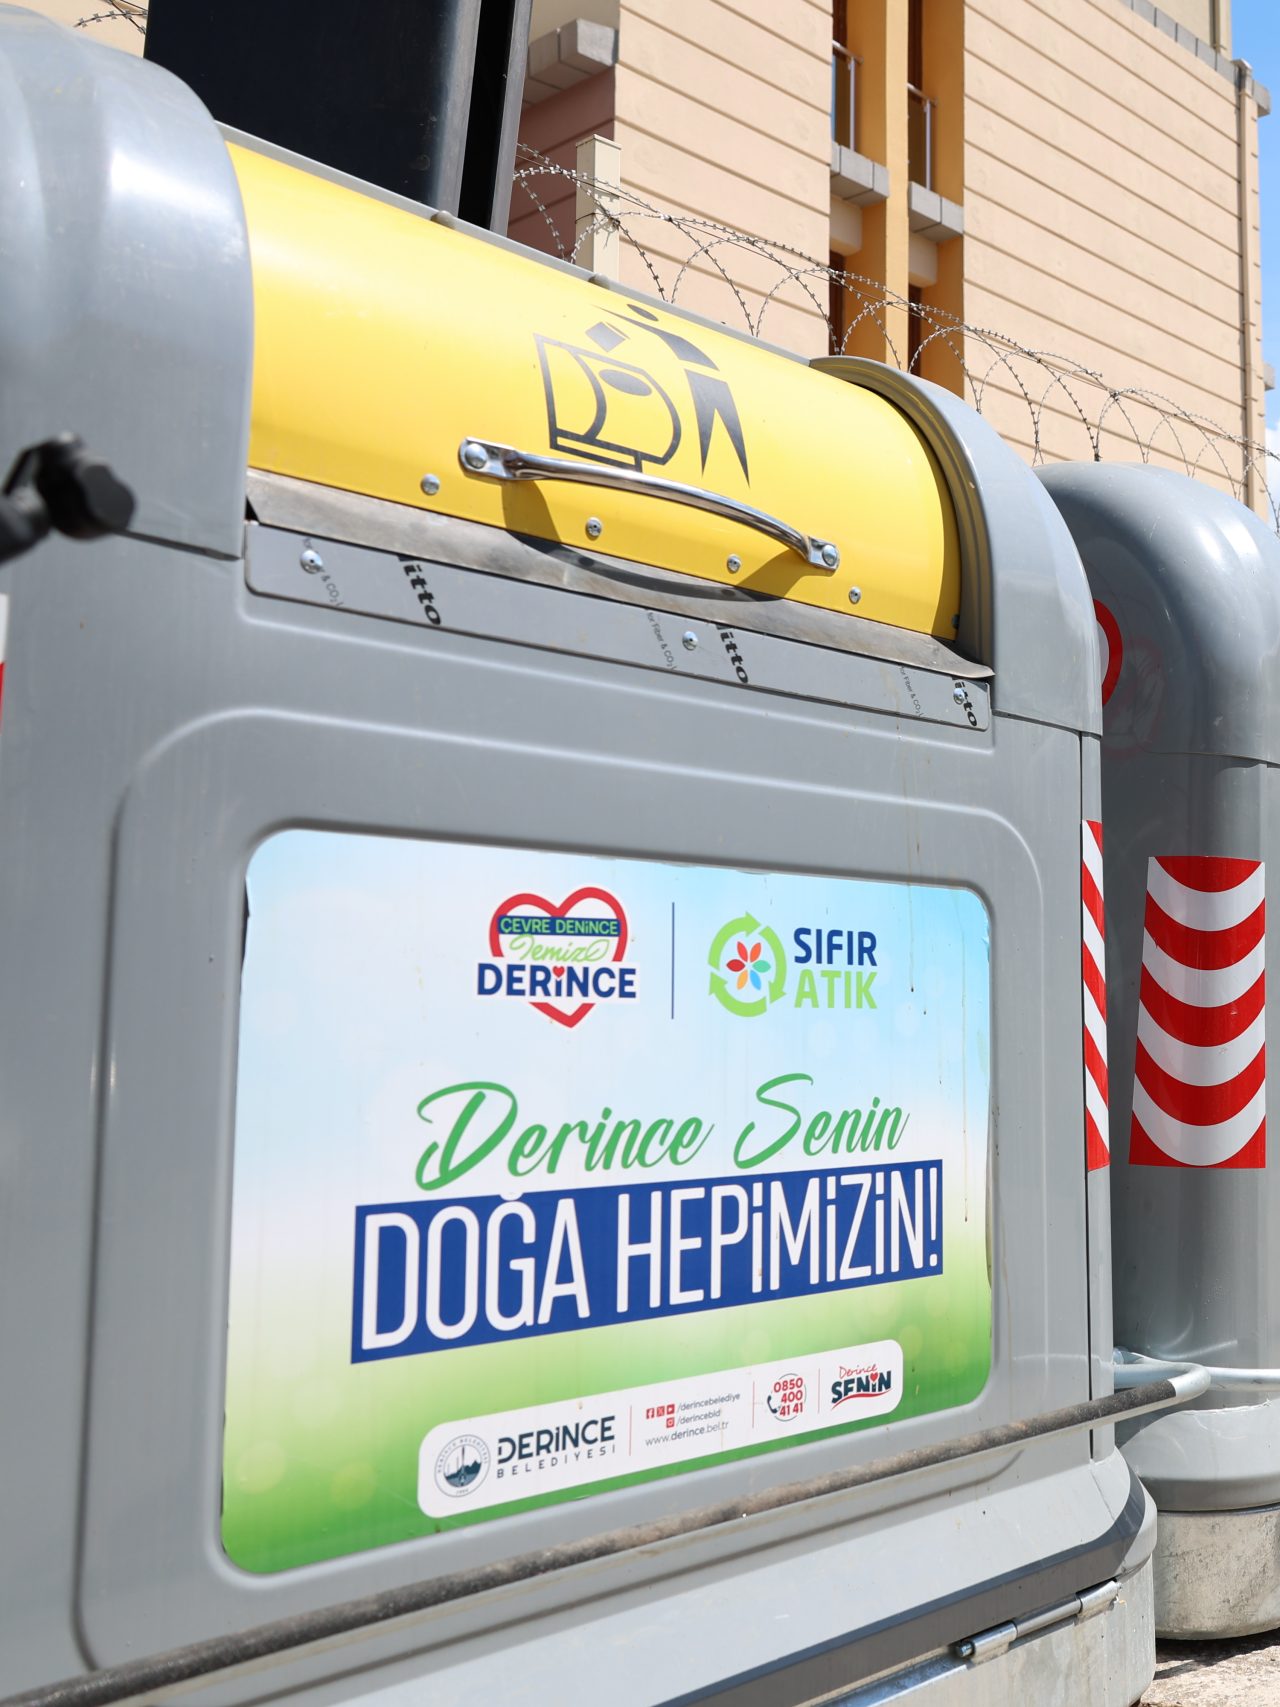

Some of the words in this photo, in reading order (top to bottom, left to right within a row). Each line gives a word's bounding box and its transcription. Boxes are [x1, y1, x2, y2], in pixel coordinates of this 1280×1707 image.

[397, 553, 442, 626] itto
[715, 624, 749, 684] itto
[793, 927, 877, 966] SIFIR
[794, 969, 877, 1009] ATIK
[415, 1081, 714, 1191] Derince
[733, 1073, 910, 1169] Senin
[362, 1191, 591, 1350] DOĞA
[773, 1377, 804, 1393] 0850
[839, 1363, 878, 1380] Derince
[779, 1405, 790, 1417] 41
[792, 1402, 803, 1413] 41
[780, 1390, 804, 1403] 400
